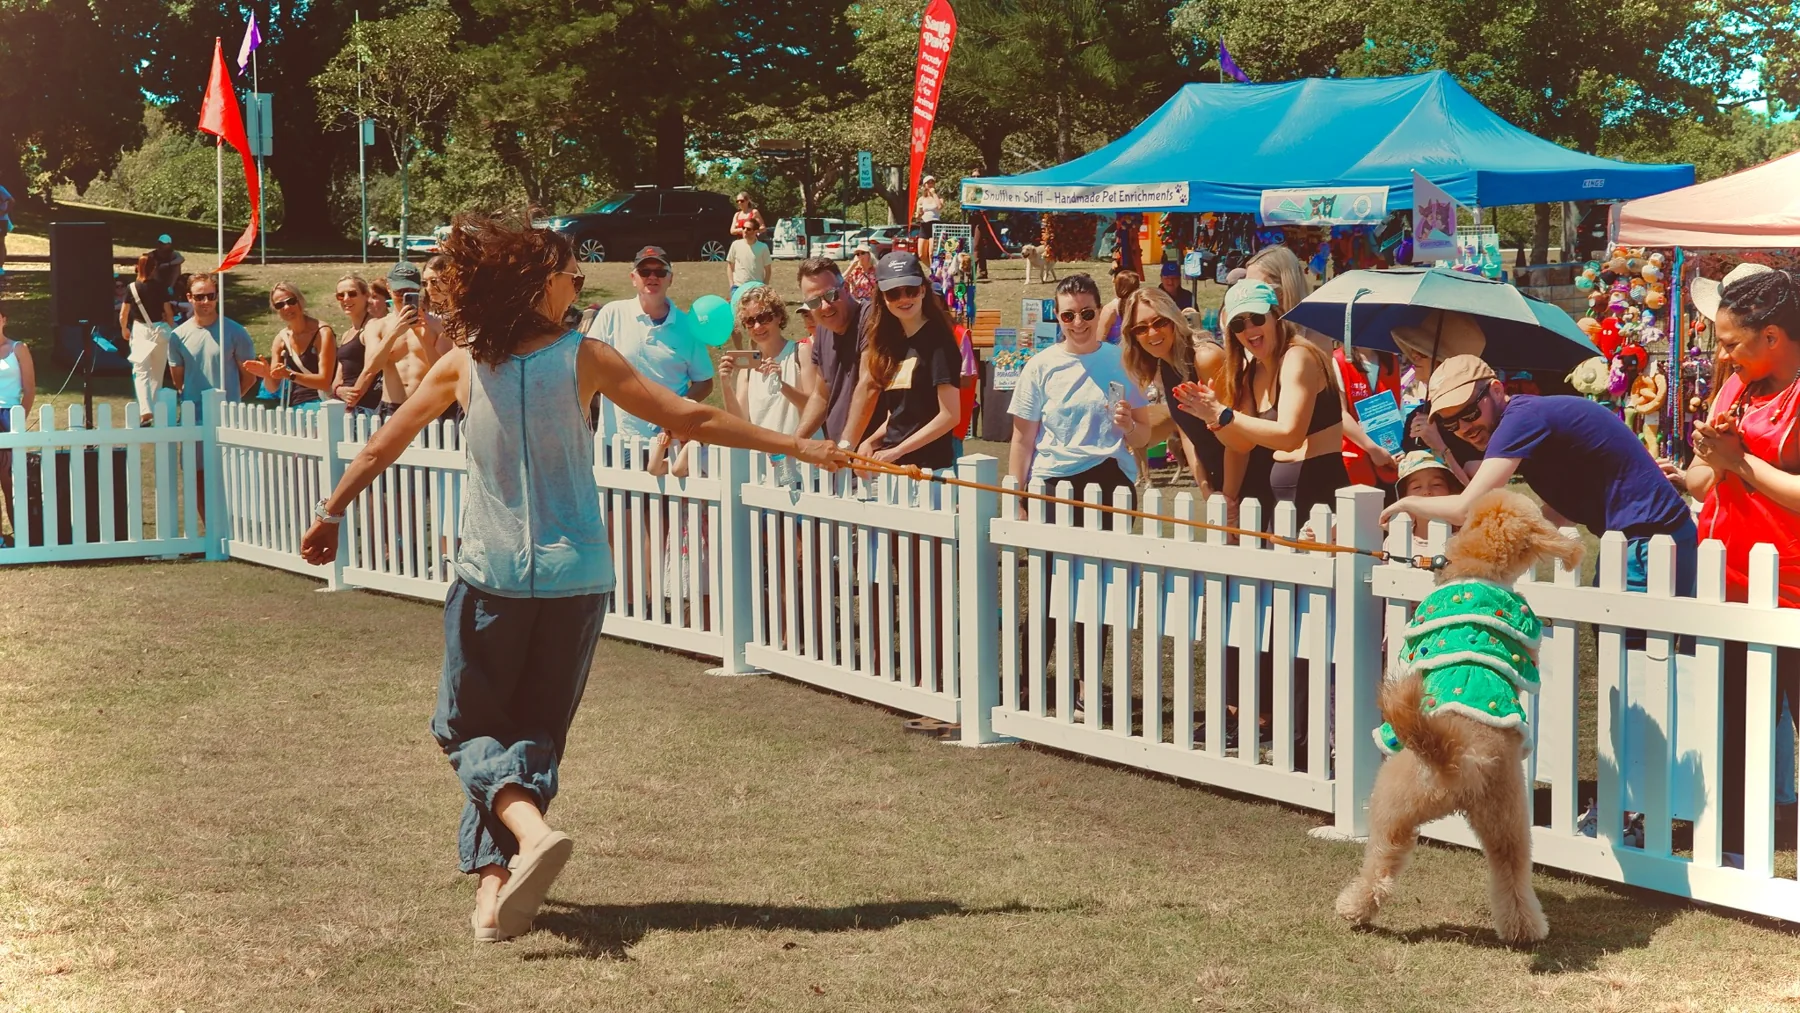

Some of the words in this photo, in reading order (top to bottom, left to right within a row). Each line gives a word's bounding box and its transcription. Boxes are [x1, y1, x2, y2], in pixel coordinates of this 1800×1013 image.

[924, 14, 951, 38] Santa
[921, 51, 943, 68] Proudly
[920, 64, 939, 79] raising
[920, 74, 936, 87] funds
[923, 86, 932, 97] for
[916, 95, 934, 110] Animal
[913, 106, 933, 121] Rescue
[1583, 179, 1604, 187] KINGS
[983, 189, 1013, 202] Snuffle
[1023, 190, 1044, 204] Sniff
[1054, 191, 1100, 204] Handmade
[1102, 190, 1117, 203] Pet
[1119, 188, 1173, 202] Enrichments
